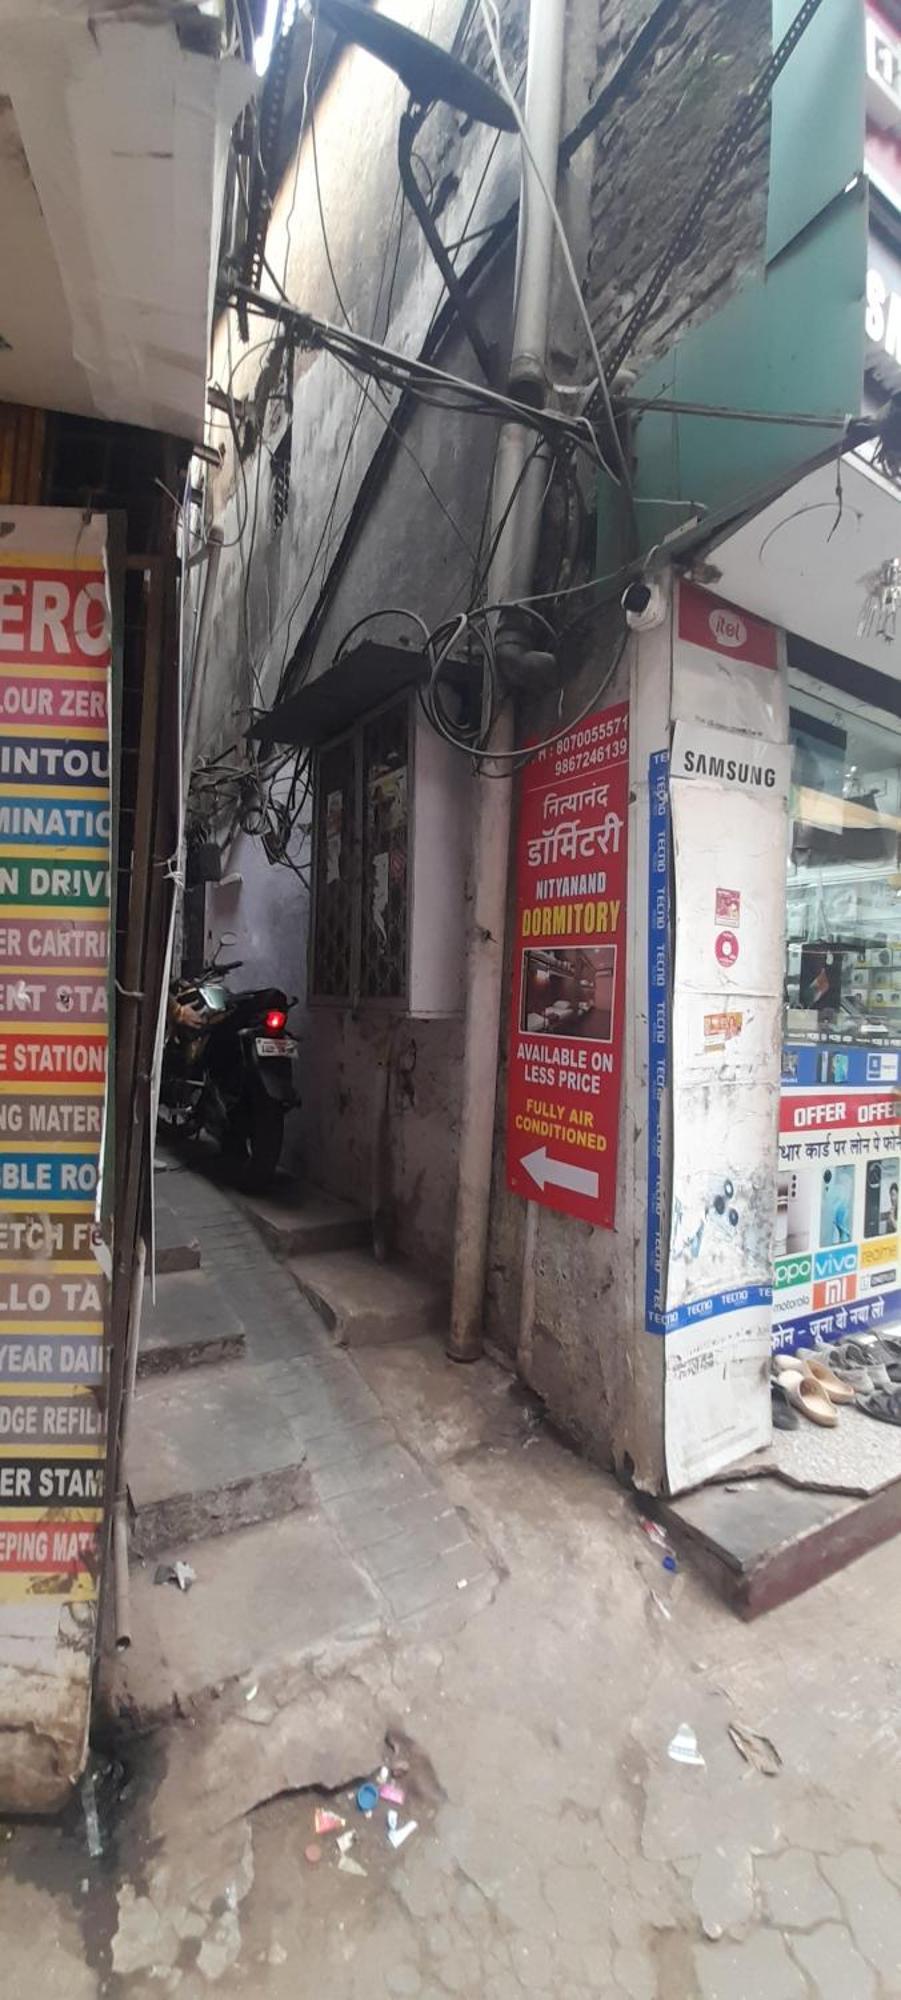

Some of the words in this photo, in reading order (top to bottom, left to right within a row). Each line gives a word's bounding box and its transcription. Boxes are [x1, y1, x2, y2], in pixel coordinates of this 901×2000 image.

[716, 614, 741, 641] itel
[0, 686, 53, 716] OUR
[60, 690, 108, 718] ZER
[556, 714, 630, 755] 8070055571
[555, 738, 627, 776] 9867246139
[684, 750, 776, 788] SAMSUNG
[543, 782, 610, 819] नित्यानंद
[528, 812, 624, 867] डॉर्मिटरी
[657, 832, 666, 872] TECNO
[31, 868, 111, 897] DRIV
[536, 872, 607, 901] NITYANAND
[522, 900, 621, 937] DORMITORY
[656, 886, 666, 929] TECNO
[656, 945, 666, 986] TECNO
[656, 1003, 666, 1044] TECNO
[517, 1043, 587, 1070] AVAILABLE
[591, 1053, 614, 1073] ON
[525, 1065, 555, 1086] LESS
[558, 1070, 601, 1095] PRICE
[526, 1099, 566, 1120] FULLY
[569, 1106, 593, 1127] AIR
[794, 1102, 846, 1127] OFFER
[515, 1114, 607, 1151] CONDITIONED
[834, 1139, 847, 1155] पर
[850, 1131, 871, 1155] लोन
[0, 1163, 52, 1190] BLE
[61, 1164, 97, 1190] RO
[816, 1253, 856, 1276] vivo
[61, 1284, 102, 1311] TA
[687, 1299, 713, 1316] TECNO
[721, 1290, 748, 1305] TECNO
[1, 1468, 31, 1497] ER
[39, 1468, 104, 1497] STAM
